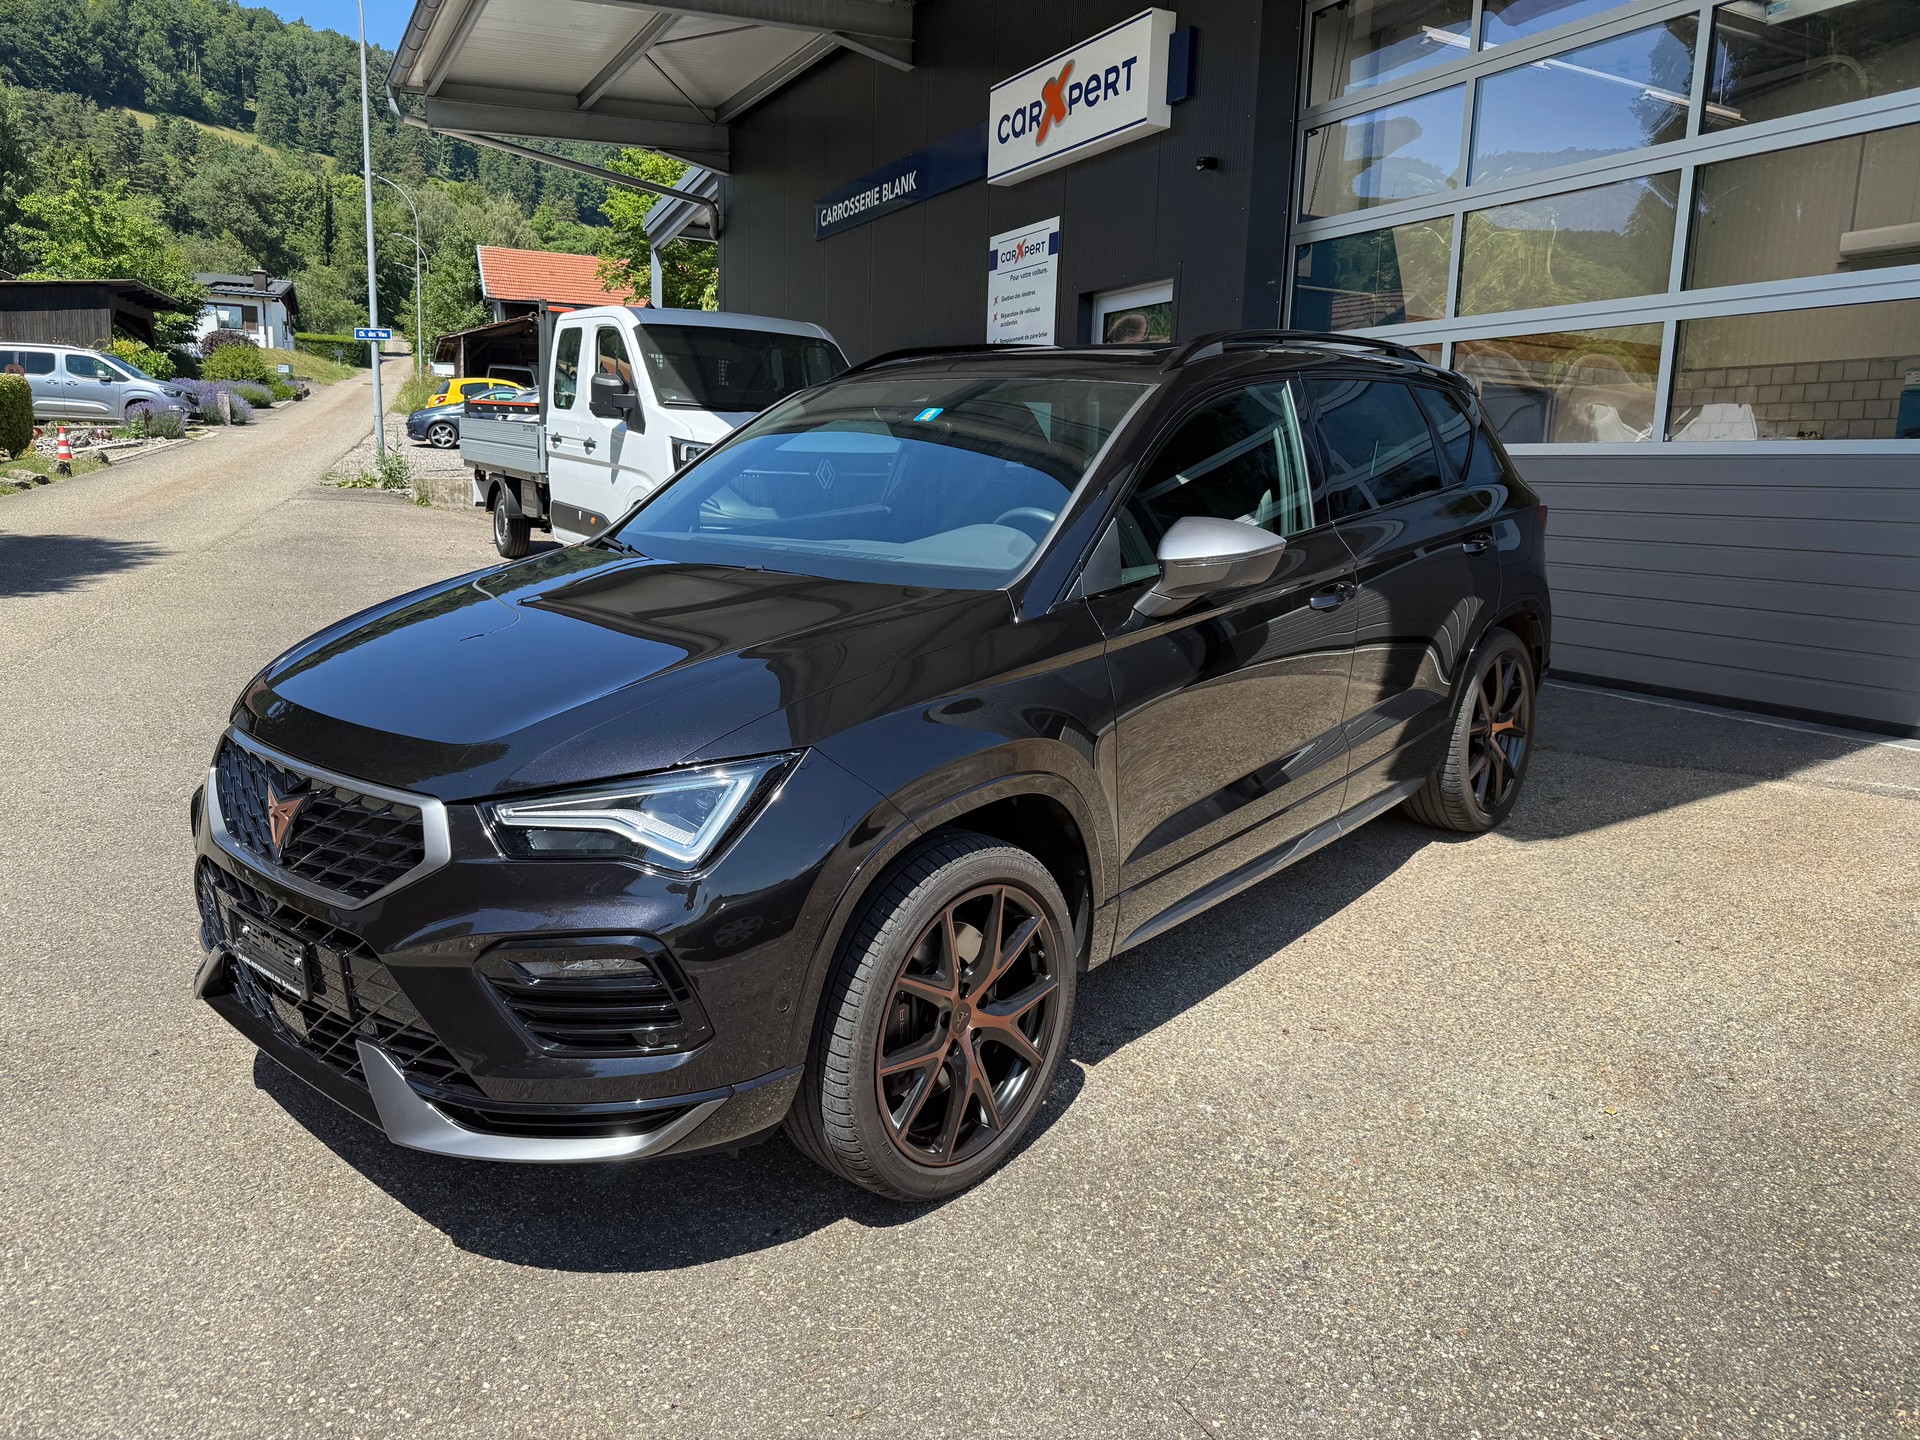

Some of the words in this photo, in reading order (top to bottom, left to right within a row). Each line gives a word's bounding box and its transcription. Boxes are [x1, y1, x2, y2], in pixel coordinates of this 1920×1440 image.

[820, 186, 880, 227] CARROSSERIE
[882, 170, 917, 202] BLANK
[1020, 271, 1031, 279] votre
